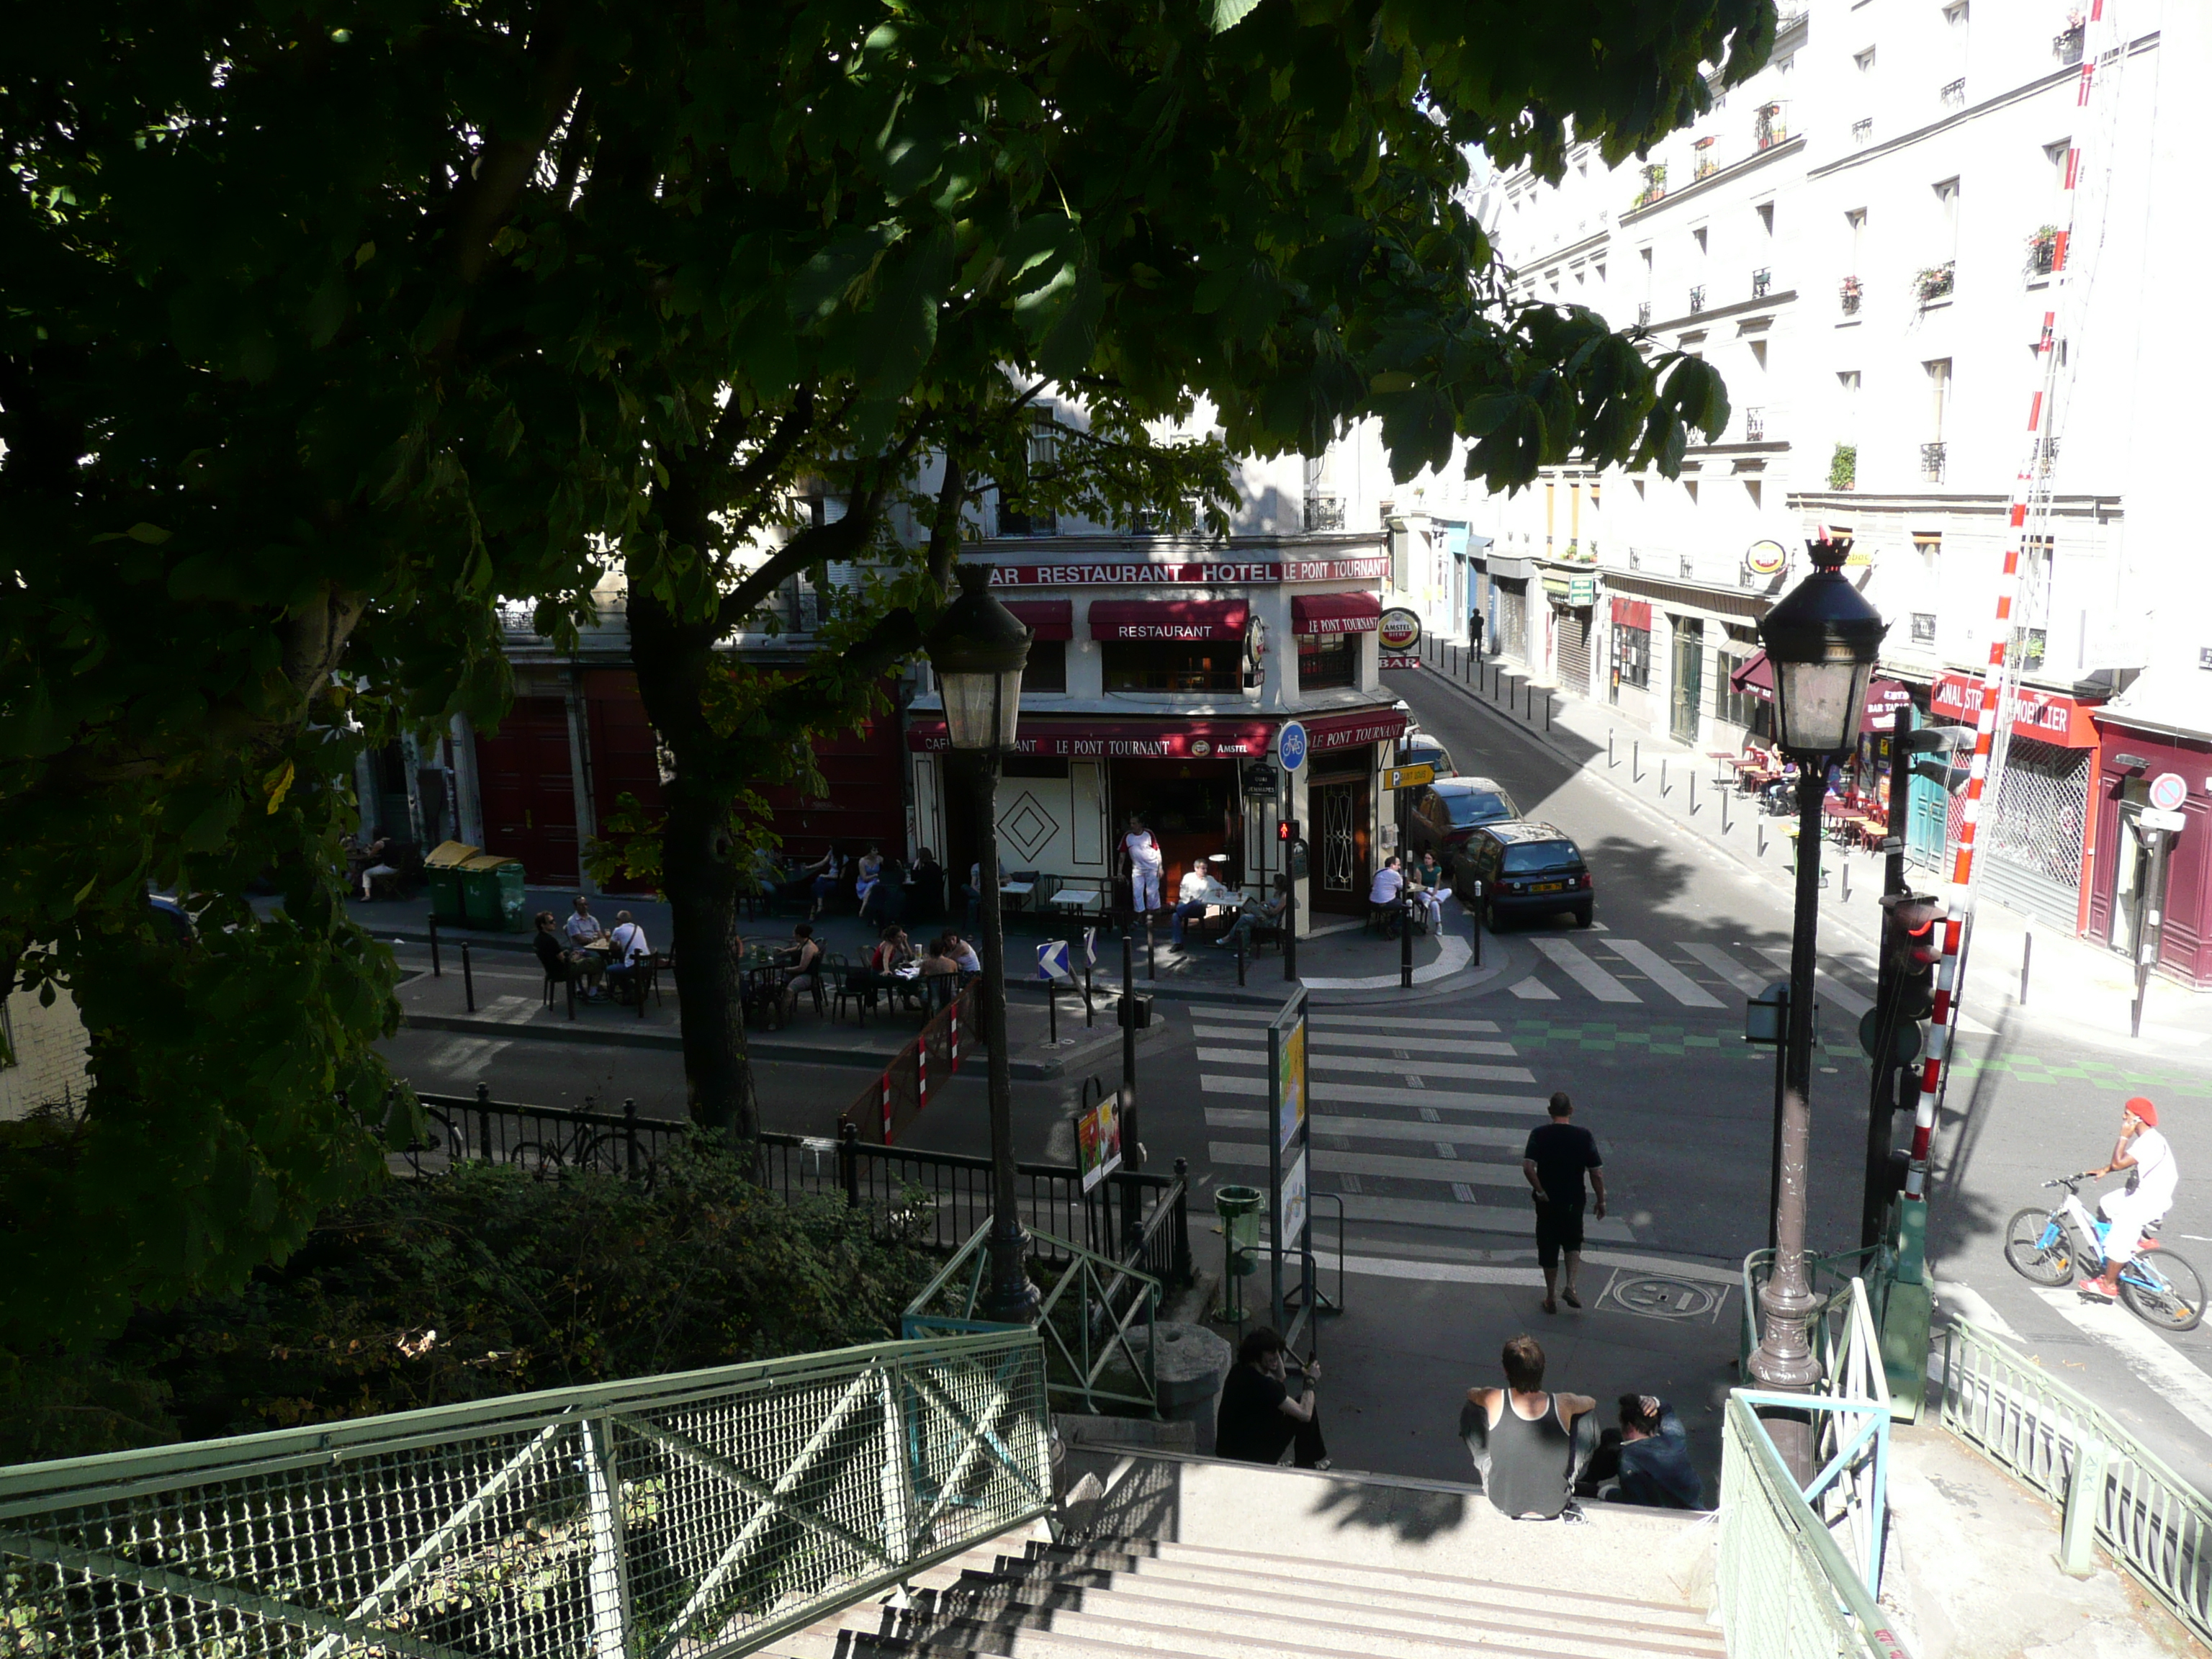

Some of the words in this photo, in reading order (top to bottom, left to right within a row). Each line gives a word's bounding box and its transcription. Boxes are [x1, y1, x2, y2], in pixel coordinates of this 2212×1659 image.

[1846, 552, 1870, 561] abac
[989, 568, 1019, 584] AR
[1037, 565, 1184, 583] RESTAURANT
[1202, 565, 1278, 581] HOTEL
[1283, 563, 1296, 580] LE
[1301, 562, 1329, 579] PONT
[1334, 559, 1388, 577] TOURNANT
[1118, 626, 1213, 637] RESTAURANT
[1309, 620, 1318, 633] LE
[1321, 619, 1341, 632] PONT
[1342, 616, 1378, 631] TOURNANT
[1378, 658, 1417, 668] BAR
[1312, 734, 1323, 748] LE
[1327, 730, 1352, 747] PONT
[1355, 723, 1403, 742] TOURNANT
[925, 738, 950, 750] CAF
[1056, 740, 1069, 754] LE
[1074, 740, 1104, 755] PONT
[1109, 740, 1170, 755] TOURNANT
